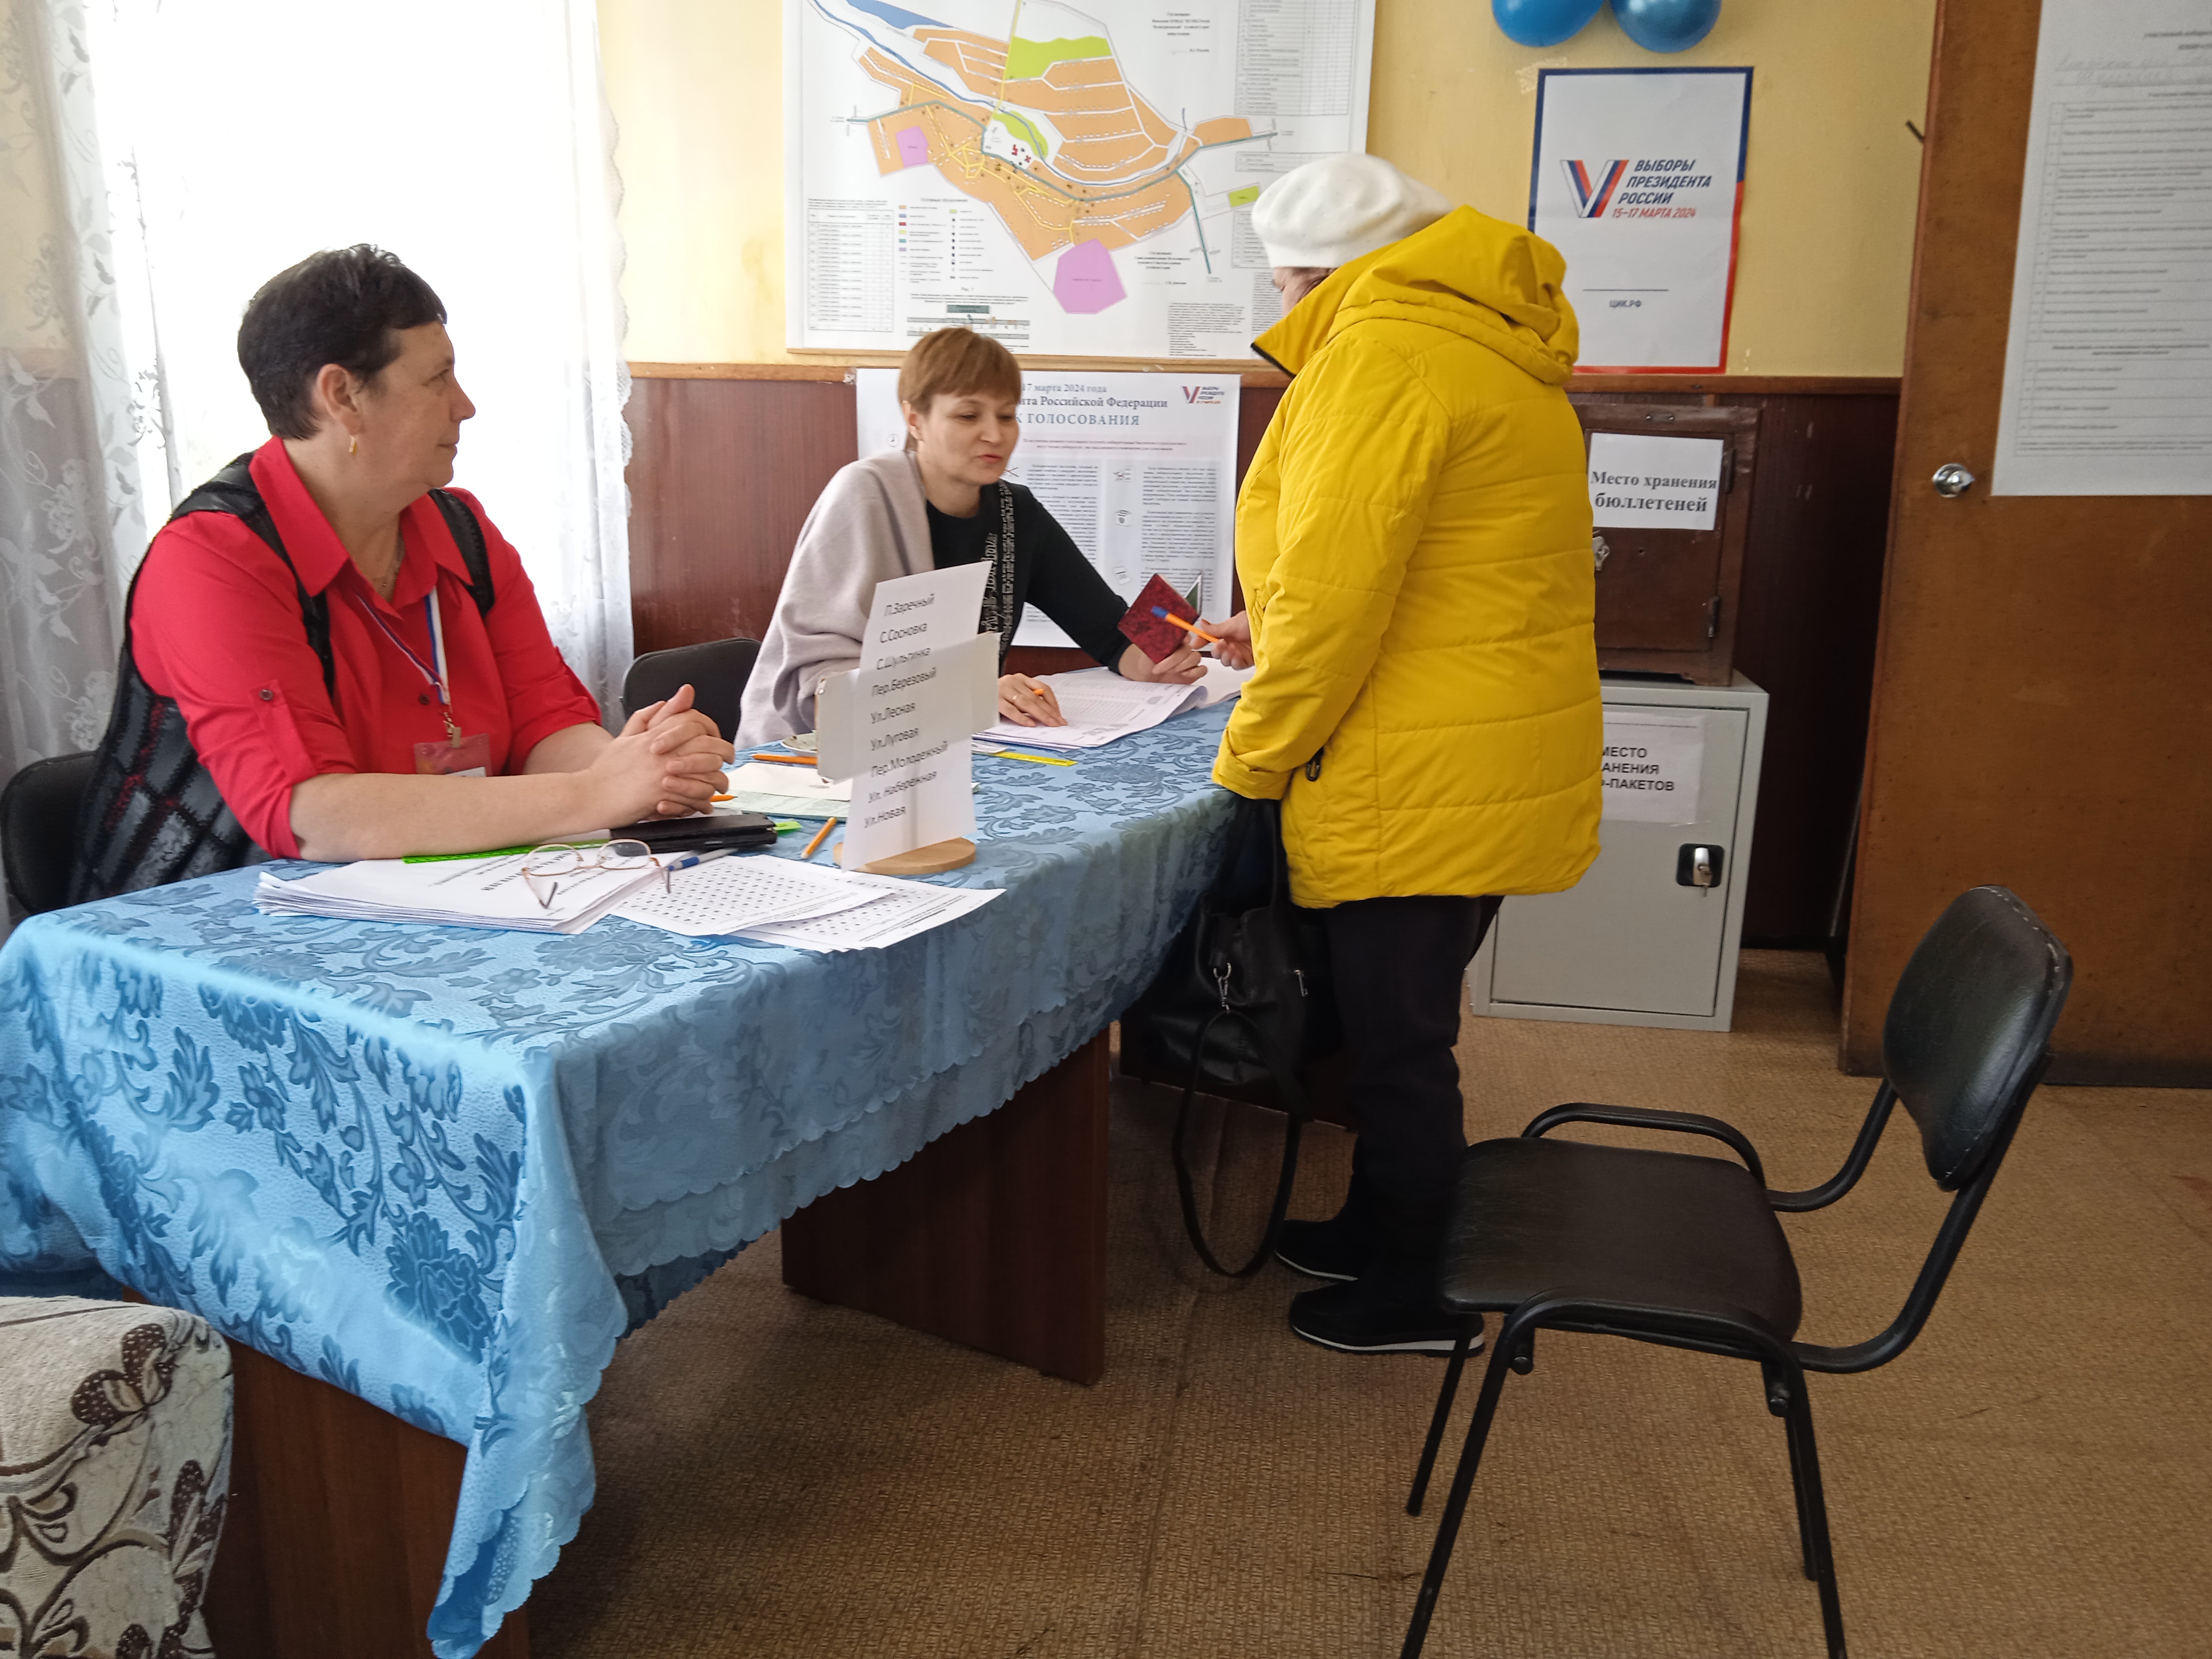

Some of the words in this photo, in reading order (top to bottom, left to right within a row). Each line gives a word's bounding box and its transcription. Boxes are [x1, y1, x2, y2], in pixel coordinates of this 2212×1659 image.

[1634, 160, 1696, 172] ВЫБОРЫ
[1626, 175, 1712, 190] ПРЕЗИДЕНТА
[1618, 191, 1674, 205] РОССИИ
[1639, 208, 1672, 218] МАРТА
[1672, 207, 1696, 218] 2024
[1609, 299, 1642, 308] ЦИК.РФ
[1034, 386, 1062, 394] марта
[1064, 384, 1085, 392] 2024
[1040, 396, 1104, 407] Российской
[1107, 398, 1168, 409] Федерации
[1027, 414, 1139, 425] ГОЛОСОВАНИЯ
[1590, 471, 1639, 485] Место
[1644, 476, 1717, 490] хранения
[1595, 492, 1707, 512] бюллетеней
[880, 623, 927, 643] С.Сосновка
[872, 667, 937, 697] Пер.Березовый
[870, 703, 916, 724] Ул.Лесная
[870, 728, 919, 751] Ул.Луговая
[1601, 763, 1660, 775] АНЕНИЯ
[883, 771, 937, 797] Набережная
[1601, 778, 1675, 791] -ПАКЕТОВ
[864, 807, 906, 828] Ул.Новая
